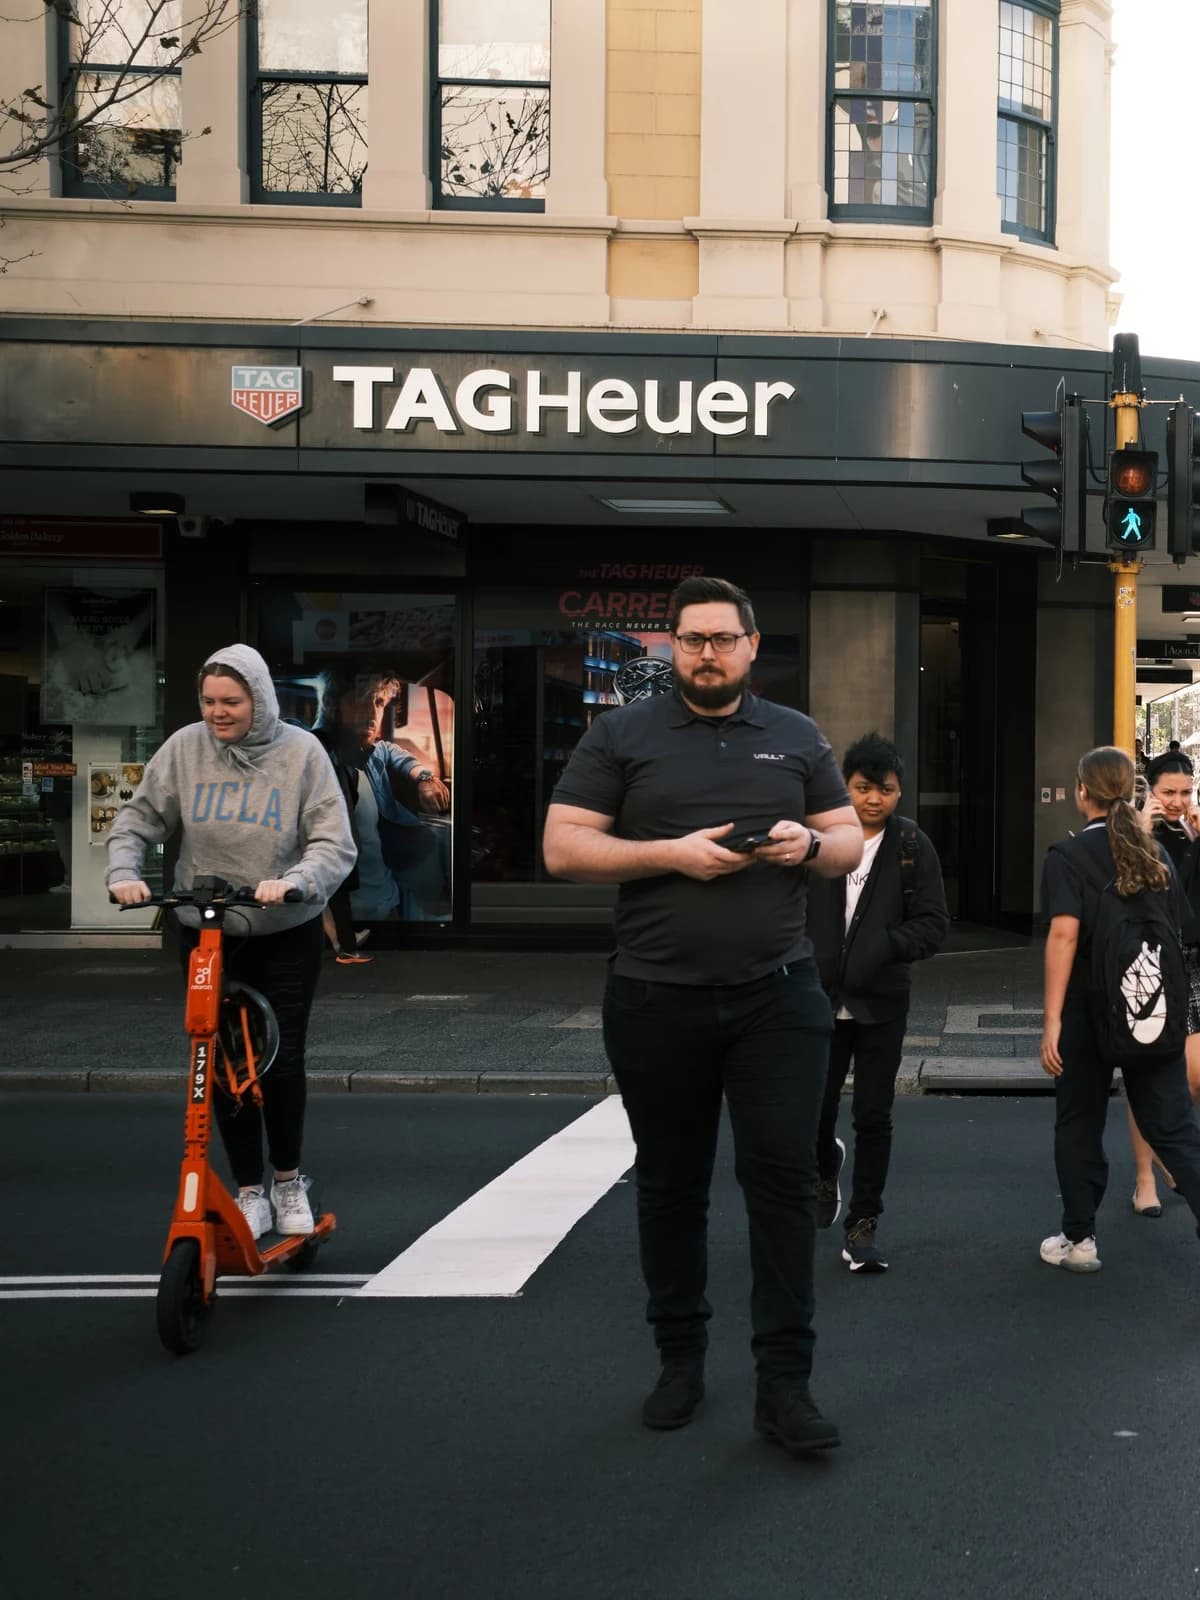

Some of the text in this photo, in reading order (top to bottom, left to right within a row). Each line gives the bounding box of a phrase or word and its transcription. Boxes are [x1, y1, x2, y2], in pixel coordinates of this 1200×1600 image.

[238, 370, 296, 388] TAG
[235, 391, 297, 419] HEUER
[600, 563, 639, 579] TAG
[639, 564, 705, 580] HEUER
[571, 621, 590, 629] THE
[98, 810, 118, 818] RAN
[191, 781, 283, 832] UCLA
[192, 1046, 207, 1099] 179X
